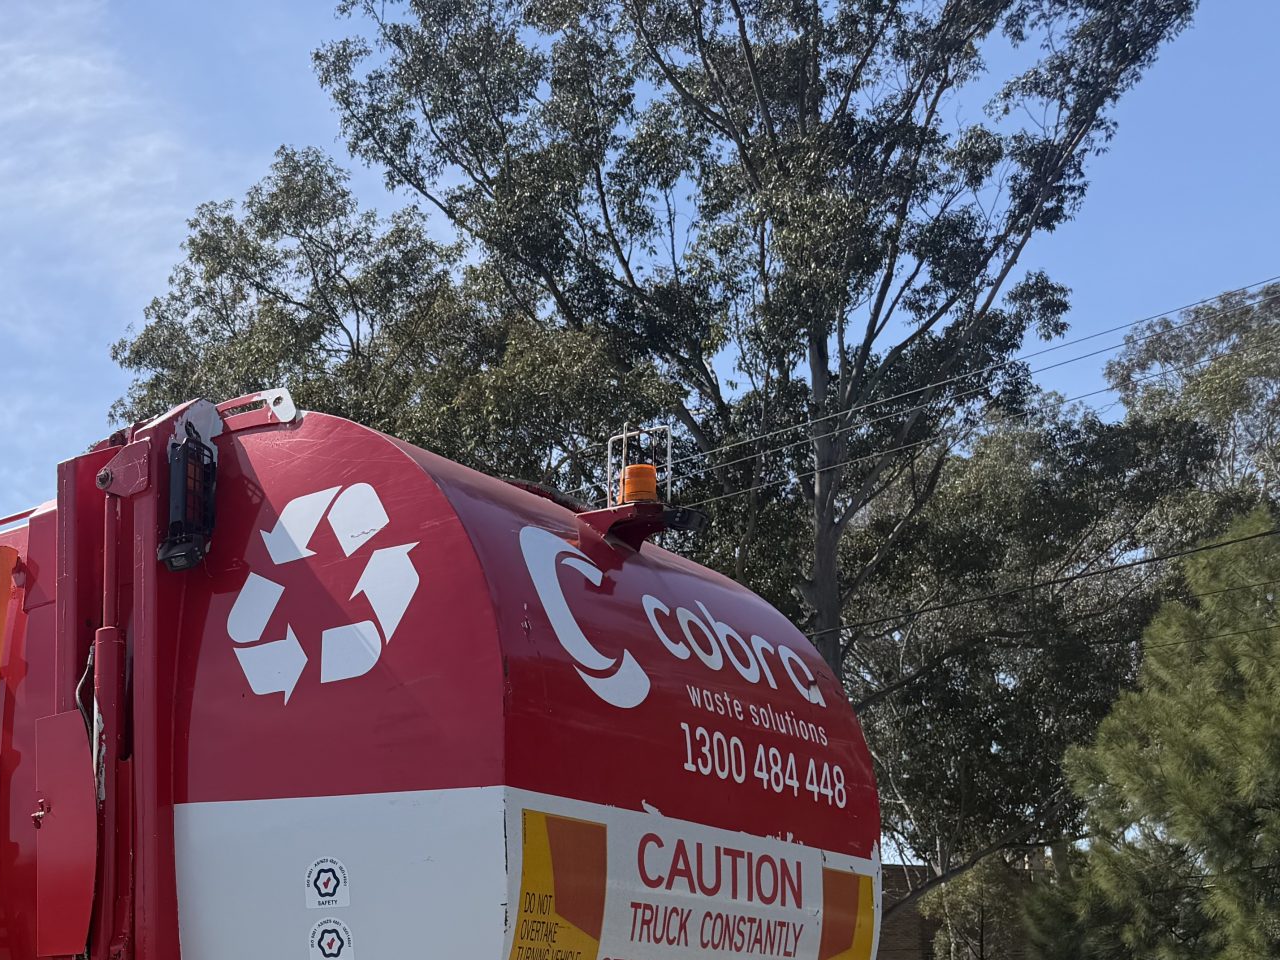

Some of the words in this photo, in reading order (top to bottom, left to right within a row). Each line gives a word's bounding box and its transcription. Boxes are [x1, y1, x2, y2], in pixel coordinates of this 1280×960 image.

[642, 594, 826, 707] cobra
[686, 684, 743, 723] waste
[752, 699, 828, 746] solutions
[681, 722, 746, 784] 1300
[754, 744, 799, 797] 484
[806, 763, 846, 808] 448
[637, 833, 802, 909] CAUTION
[521, 919, 558, 944] OVERTAKE
[524, 892, 536, 913] DO
[537, 894, 553, 915] NOT
[630, 902, 693, 946] TRUCK
[700, 911, 804, 958] CONSTANTLY
